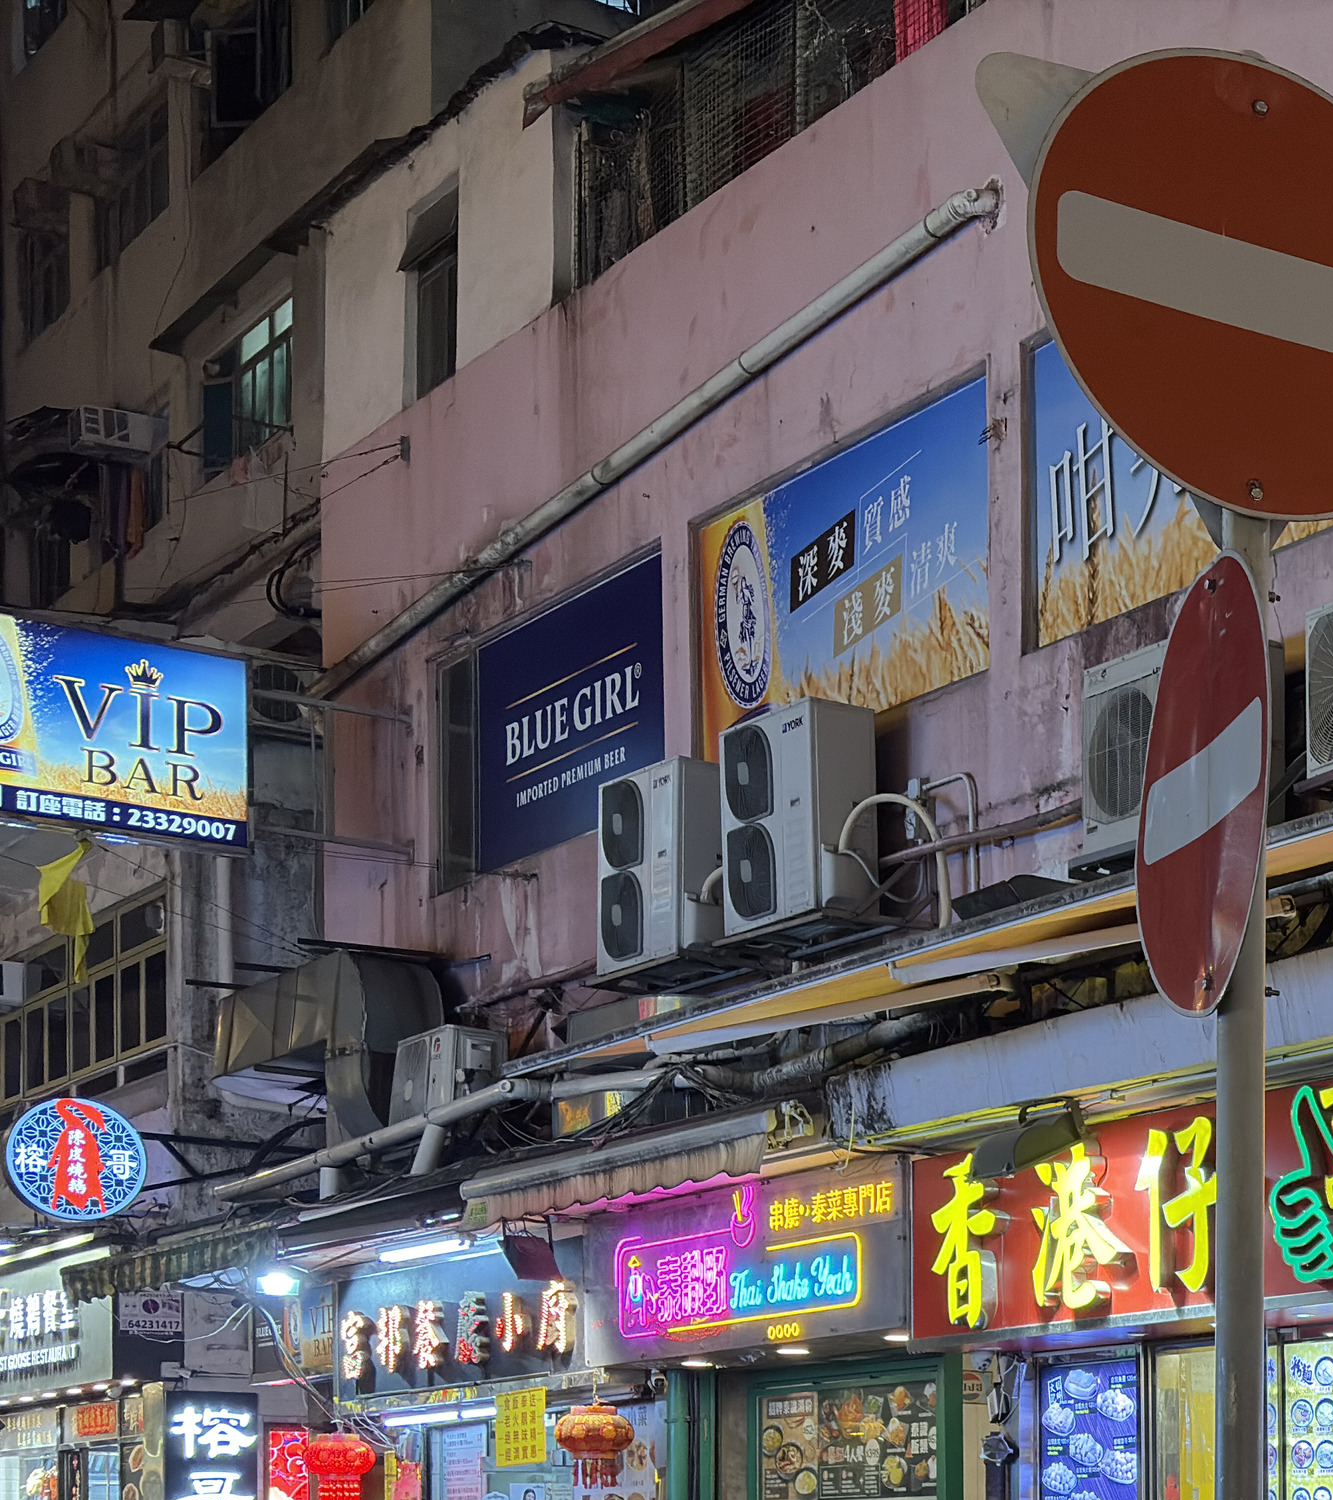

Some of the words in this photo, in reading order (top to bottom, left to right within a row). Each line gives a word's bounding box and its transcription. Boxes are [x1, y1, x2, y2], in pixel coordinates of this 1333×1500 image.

[52, 674, 224, 758] VIP
[505, 696, 569, 767] BLUE
[80, 745, 204, 801] BAR
[516, 774, 559, 808] IMPORTED
[561, 757, 602, 787] PREMIUM
[603, 746, 626, 769] BEER
[728, 1268, 763, 1310] Thai
[766, 1262, 810, 1304] Shake
[809, 1254, 854, 1298] Yeah
[127, 1319, 181, 1331] 64231417
